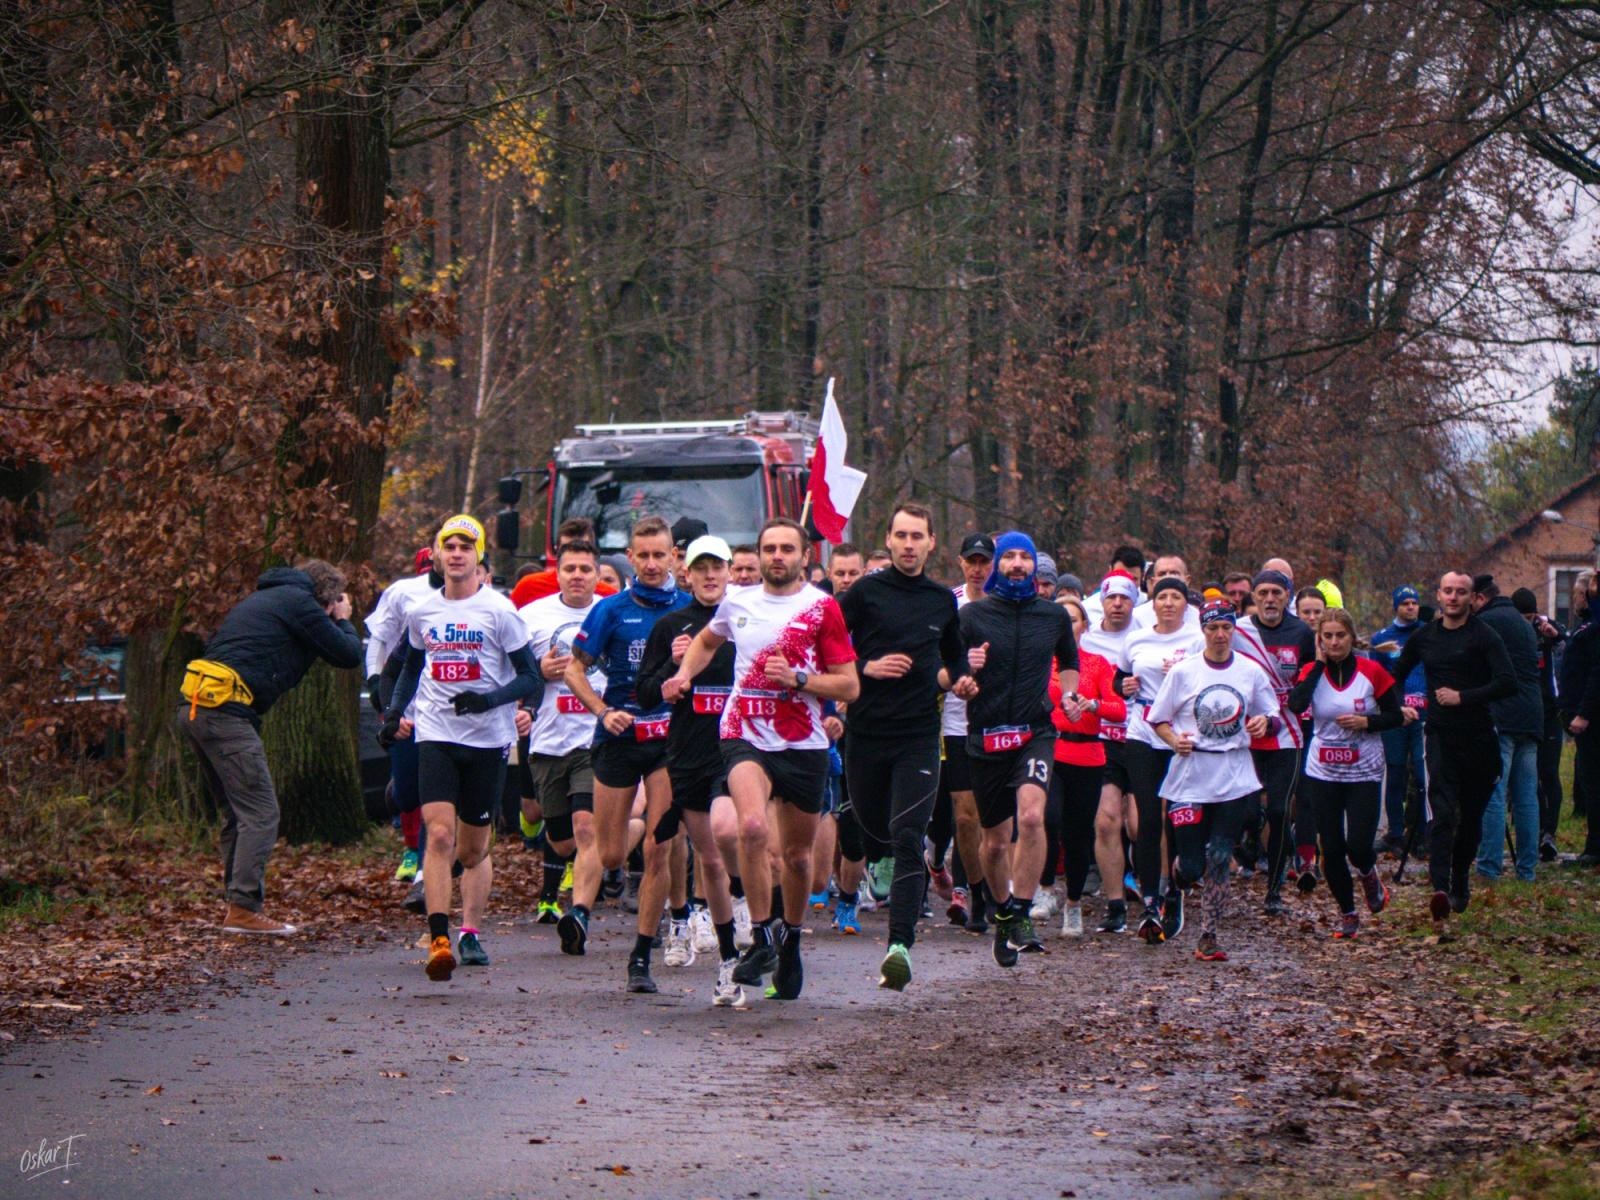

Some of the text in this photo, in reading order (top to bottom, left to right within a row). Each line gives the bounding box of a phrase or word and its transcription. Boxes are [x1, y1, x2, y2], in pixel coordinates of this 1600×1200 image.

[439, 664, 470, 680] 182
[704, 697, 725, 712] 18
[746, 700, 777, 716] 113
[993, 734, 1023, 750] 164
[1325, 749, 1353, 762] 089
[1027, 758, 1049, 783] 13
[1172, 809, 1195, 825] 253
